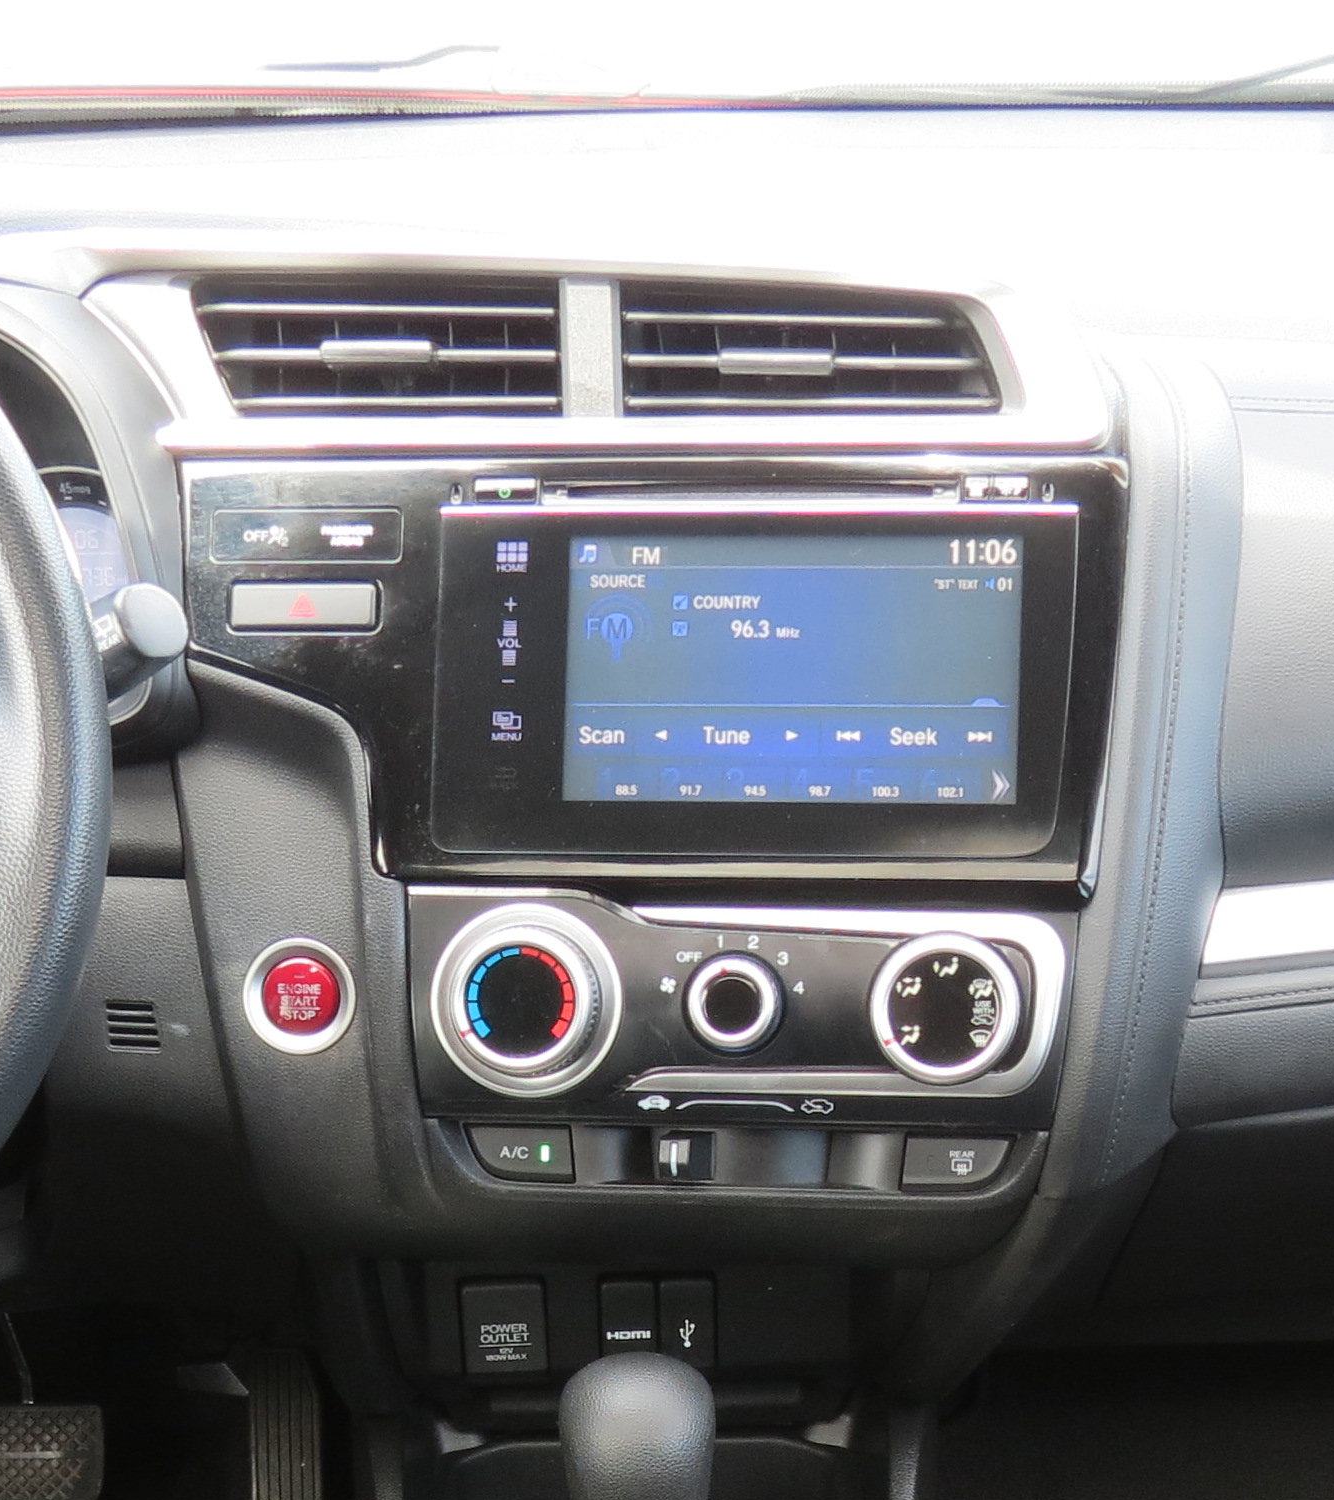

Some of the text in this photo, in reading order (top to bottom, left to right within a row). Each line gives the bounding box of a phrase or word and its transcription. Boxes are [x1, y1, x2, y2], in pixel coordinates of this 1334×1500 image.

[243, 528, 269, 543] OFF
[631, 538, 1018, 565] FM 11:06
[495, 563, 528, 573] HOME
[589, 574, 647, 589] SOURCE
[997, 577, 1014, 591] 01
[692, 595, 762, 610] COUNTRY
[730, 619, 801, 639] 96.3 MHz
[496, 637, 522, 648] VOL
[491, 732, 523, 742] MENU
[578, 725, 625, 745] Scan
[702, 725, 751, 745] Tune
[889, 726, 938, 746] Seek
[614, 784, 638, 796] 88.5
[679, 784, 703, 796] 91.7
[743, 785, 767, 797] 94.5
[808, 785, 832, 797] 98.7
[872, 786, 900, 798] 100.3
[937, 786, 964, 798] 102.1
[717, 935, 724, 948] 1
[747, 935, 760, 949] 2
[676, 951, 703, 963] OFF
[777, 951, 789, 966] 3
[277, 983, 322, 994] ENGINE
[792, 980, 805, 995] 4
[280, 994, 319, 1006] START
[974, 1000, 992, 1008] USE
[283, 1010, 317, 1021] STOP
[499, 1146, 530, 1160] A/C
[949, 1150, 976, 1158] REAR
[480, 1323, 528, 1334] POWER
[480, 1332, 530, 1343] OUTLET
[606, 1329, 652, 1341] HDMI
[507, 1353, 528, 1361] MAX
